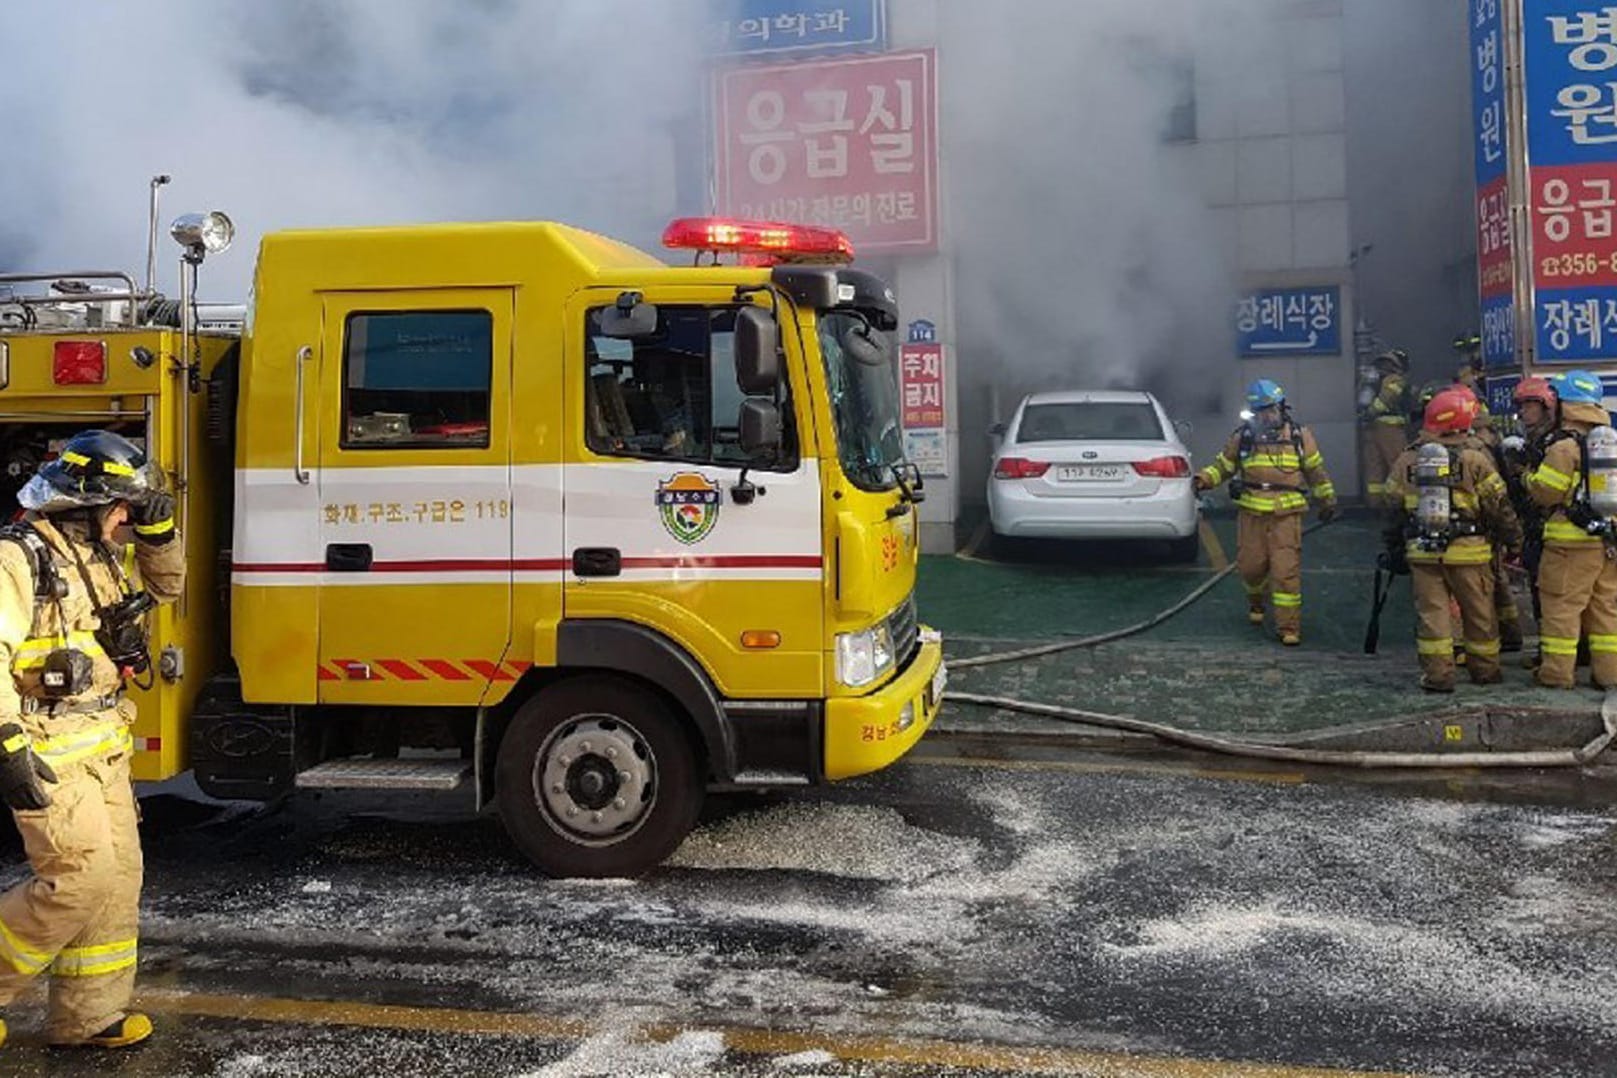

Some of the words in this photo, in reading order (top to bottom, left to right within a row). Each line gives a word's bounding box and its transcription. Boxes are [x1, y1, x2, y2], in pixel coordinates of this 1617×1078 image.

[739, 79, 914, 185] 응급실
[876, 191, 917, 224] 진료
[1537, 179, 1616, 242] 응급
[1236, 293, 1334, 332] 장례식장
[912, 329, 932, 341] 114
[904, 353, 940, 379] 주차
[905, 382, 940, 407] 금지
[475, 500, 508, 519] 119
